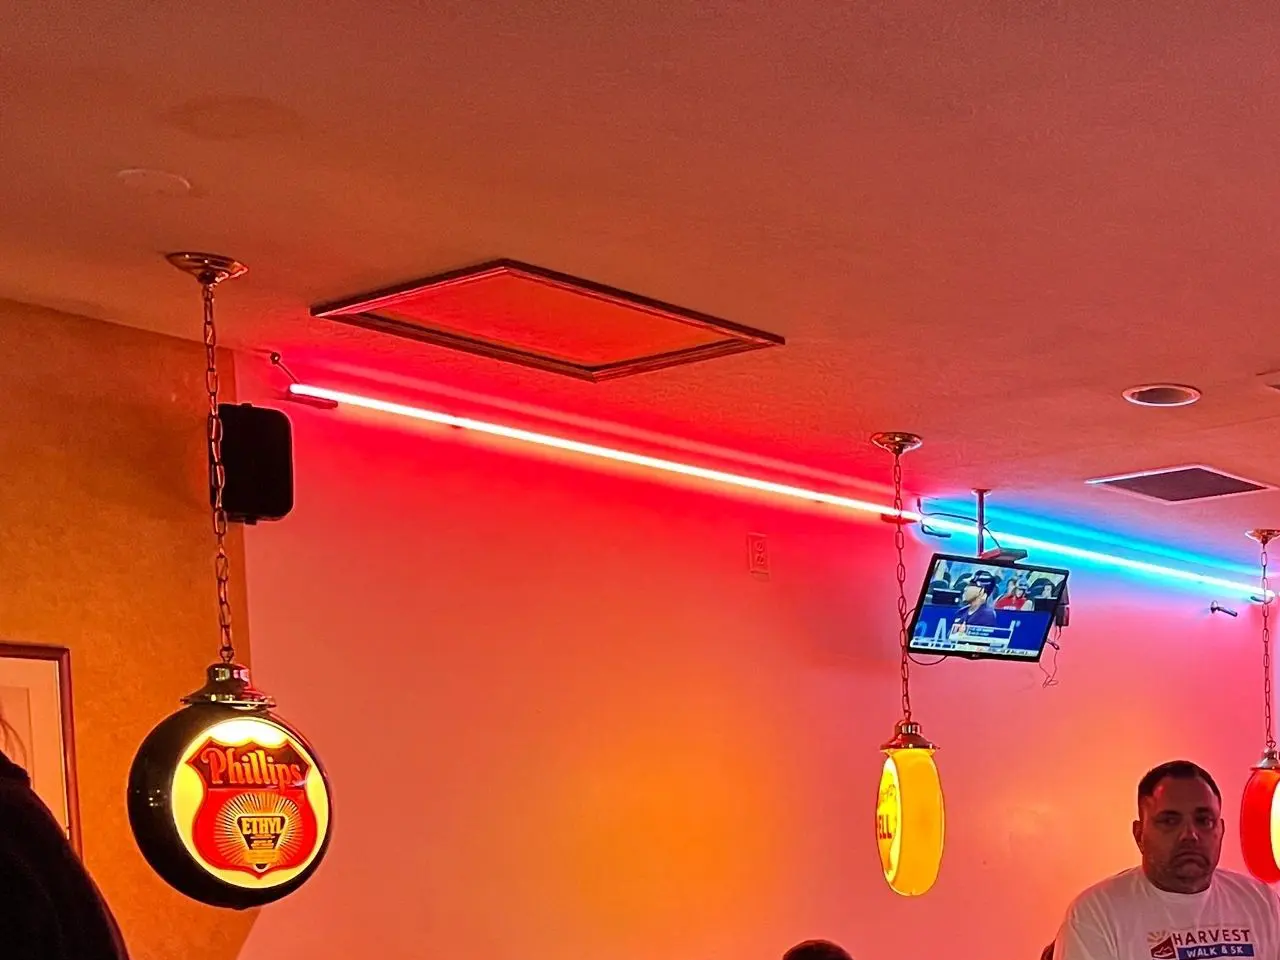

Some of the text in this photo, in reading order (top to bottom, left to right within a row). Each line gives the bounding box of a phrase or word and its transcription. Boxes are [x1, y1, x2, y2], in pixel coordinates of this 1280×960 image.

[201, 747, 302, 792] Phillips
[241, 817, 282, 835] ETHYL
[1172, 929, 1250, 946] HARVEST
[1186, 944, 1245, 959] WALK & 5K
